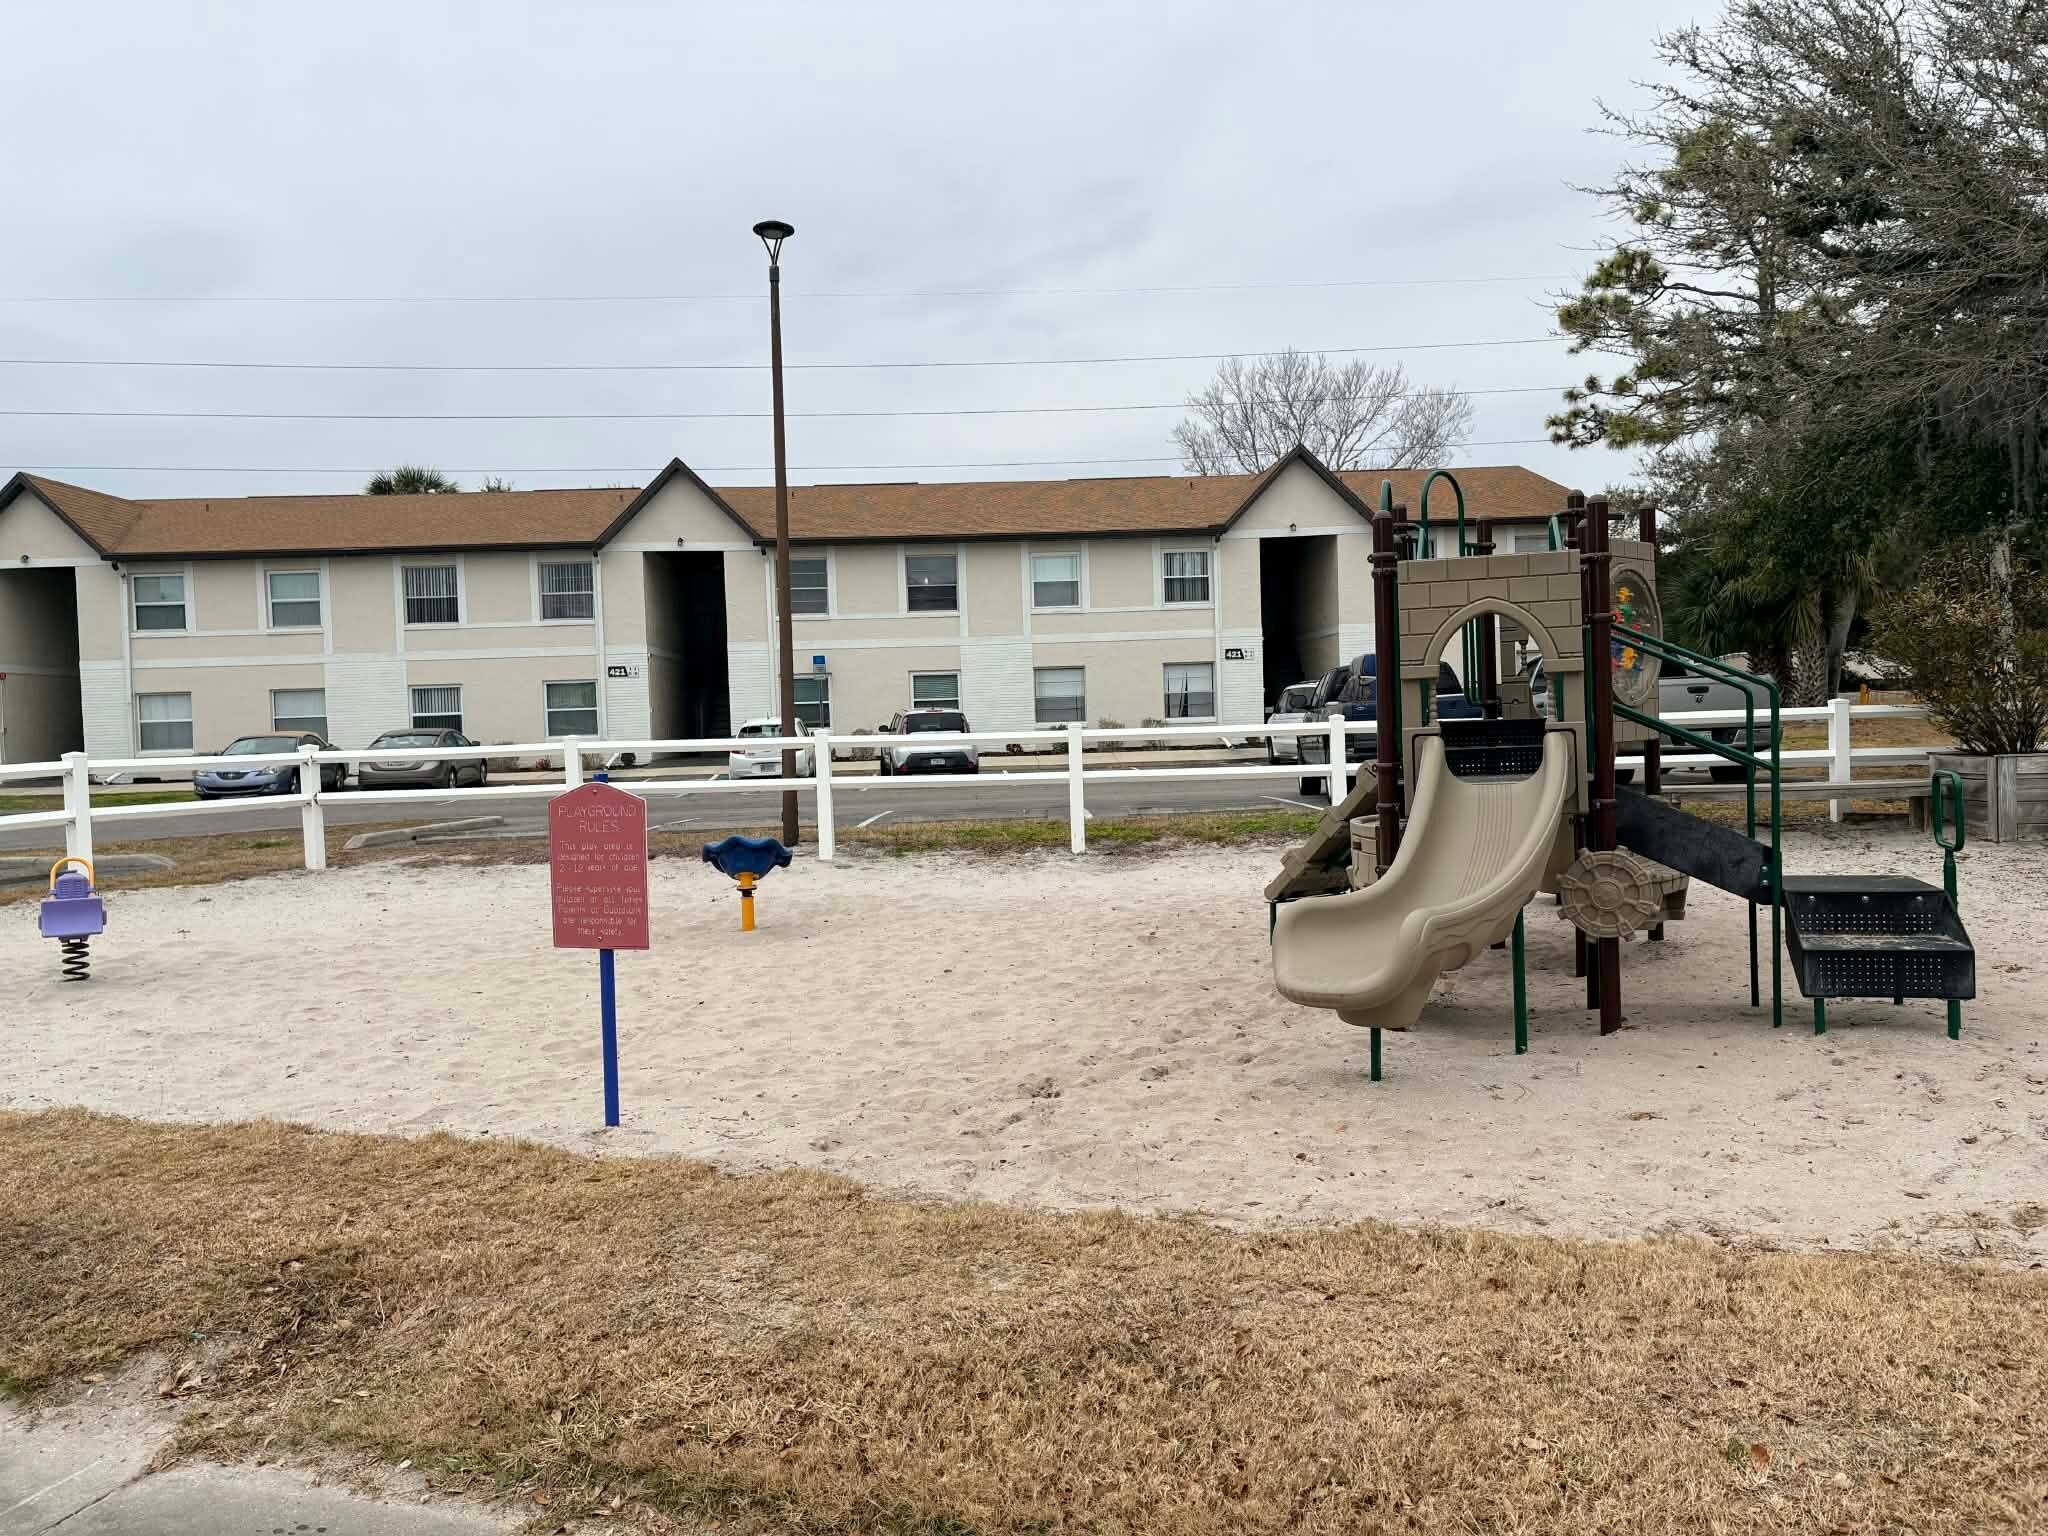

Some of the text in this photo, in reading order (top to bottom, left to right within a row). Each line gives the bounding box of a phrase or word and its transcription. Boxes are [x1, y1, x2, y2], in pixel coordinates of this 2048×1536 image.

[1226, 649, 1241, 658] 421
[609, 667, 626, 676] 421
[558, 806, 637, 818] PLAYGROUND
[579, 820, 620, 833] RULES
[560, 840, 576, 851] This
[582, 841, 598, 852] play
[603, 843, 621, 851] area
[594, 853, 605, 862] for
[608, 853, 640, 862] children
